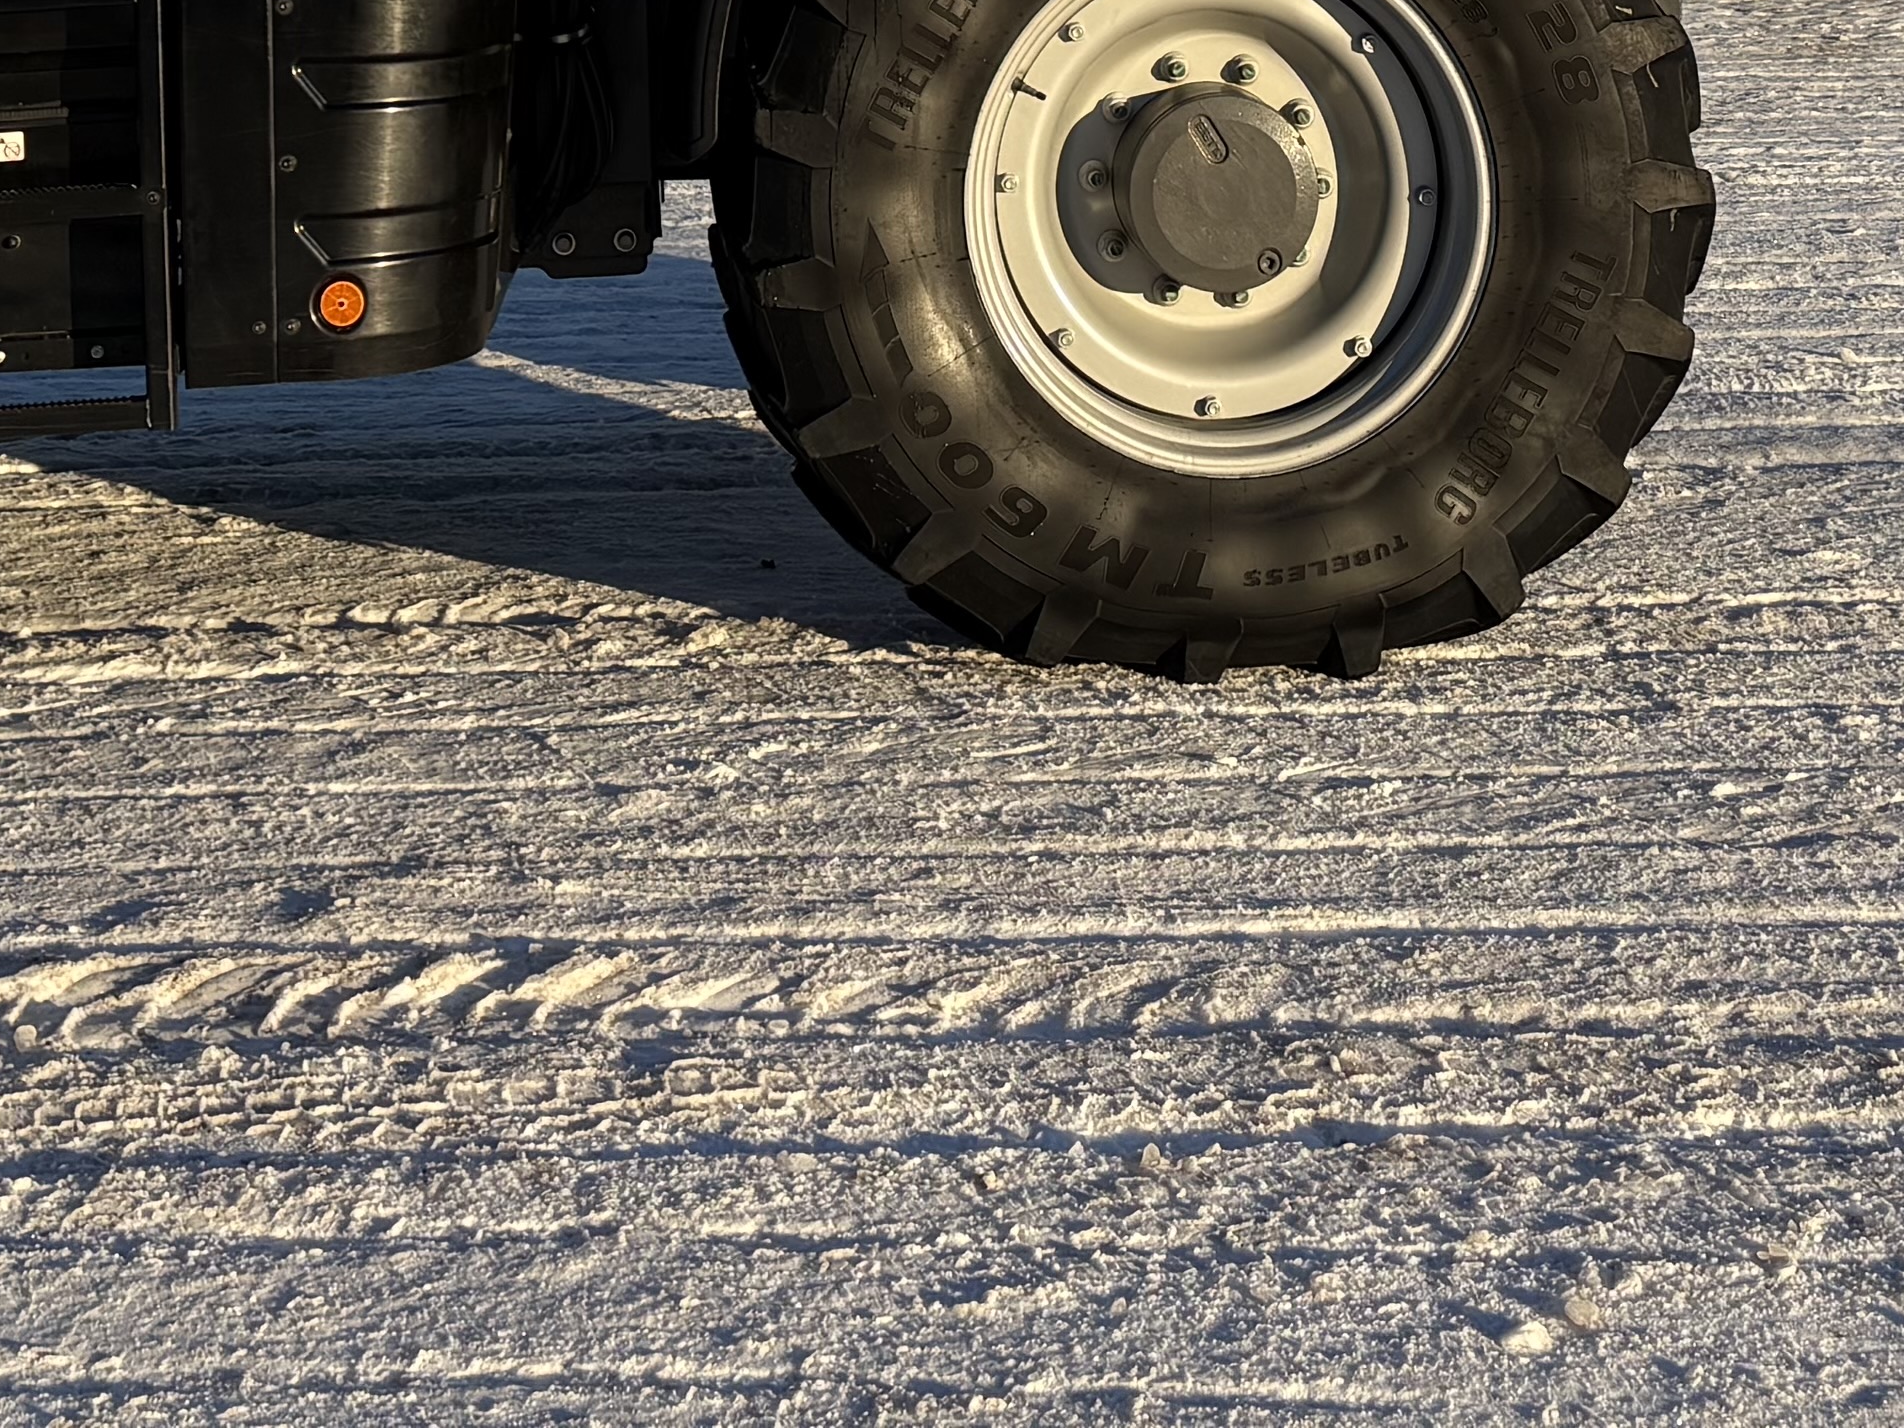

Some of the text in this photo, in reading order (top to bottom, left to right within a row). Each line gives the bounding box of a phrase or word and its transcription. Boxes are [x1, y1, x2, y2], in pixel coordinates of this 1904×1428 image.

[1526, 0, 1602, 105] 28
[1434, 250, 1617, 526] TRELLEBORG
[899, 390, 1214, 601] TM 600
[1243, 534, 1410, 588] TUBELESS
